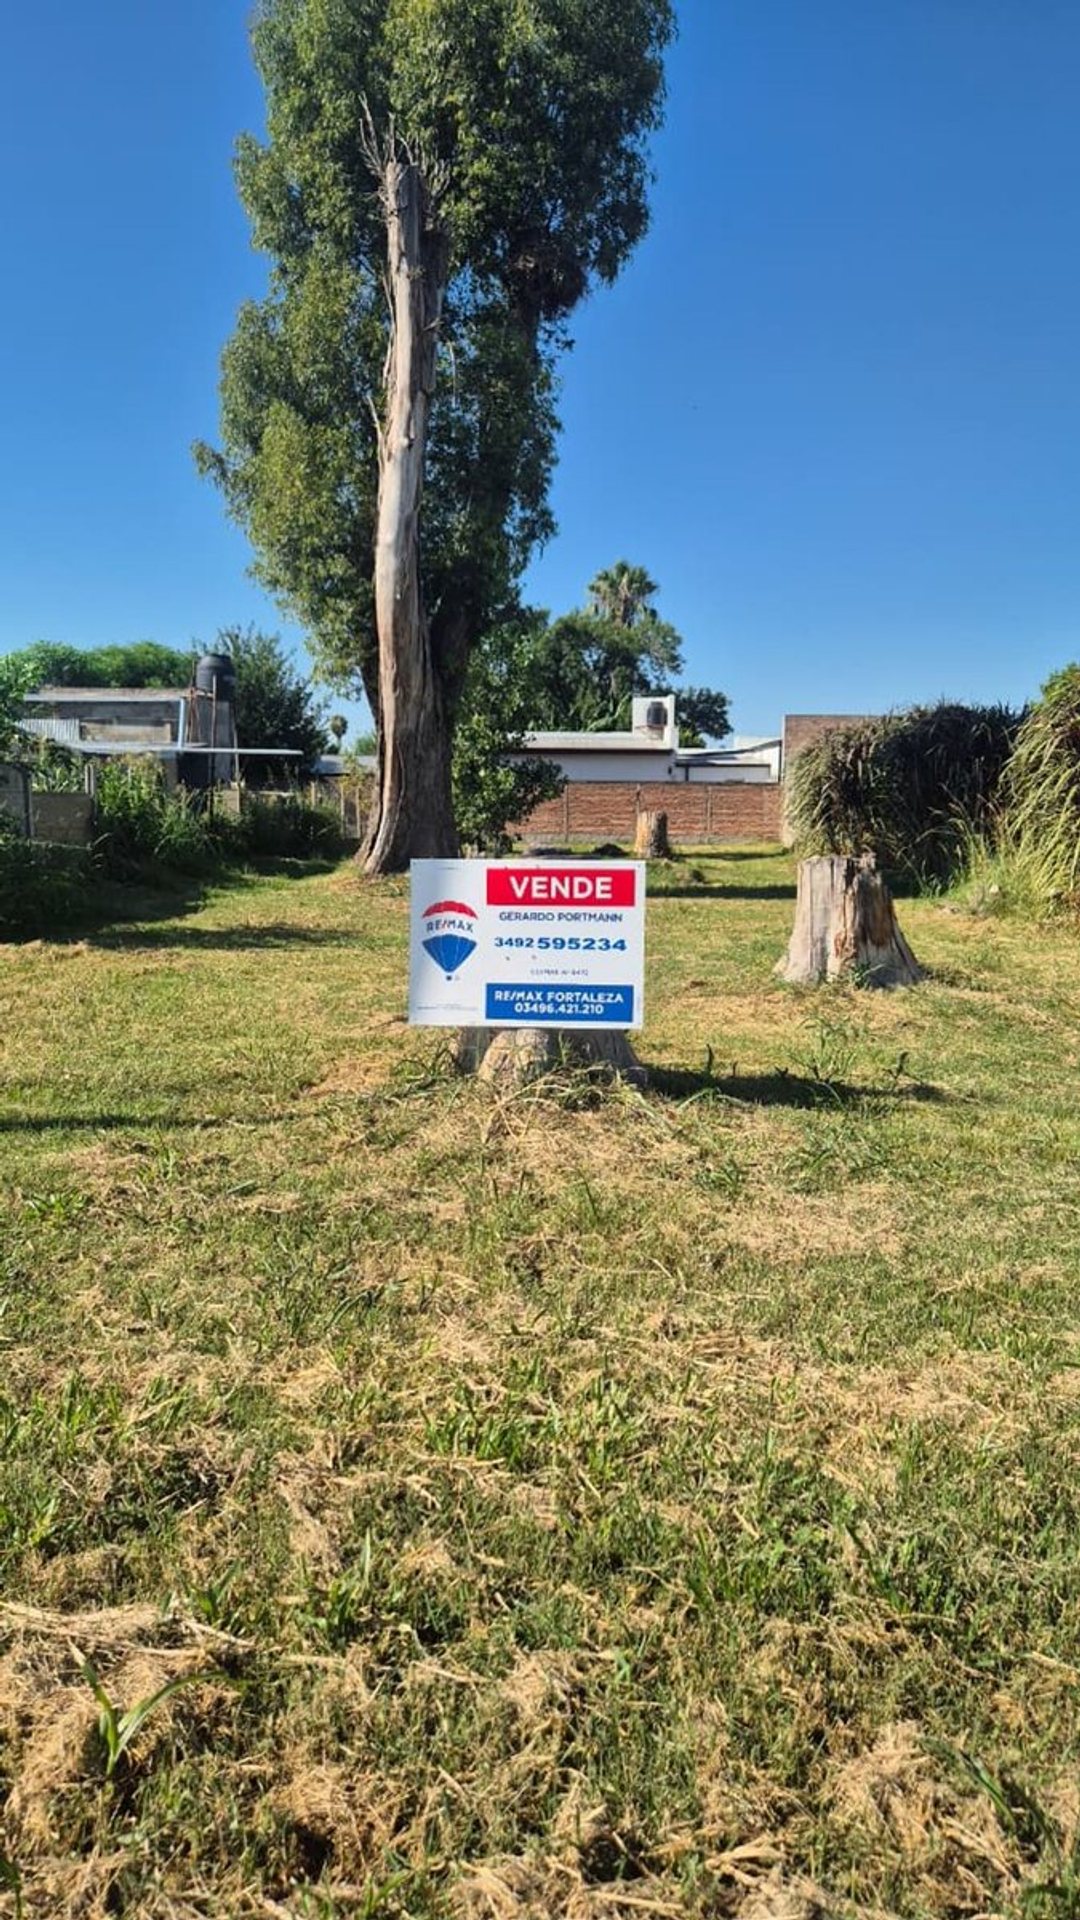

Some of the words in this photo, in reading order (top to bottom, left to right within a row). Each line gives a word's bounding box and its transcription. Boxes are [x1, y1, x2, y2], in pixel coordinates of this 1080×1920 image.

[510, 876, 613, 899] VENDE
[499, 911, 555, 922] GERARDO
[557, 912, 623, 923] PORTMANN
[426, 919, 473, 933] RE/MAX
[537, 937, 627, 951] 595234
[494, 991, 543, 1002] RE/MAX
[547, 992, 623, 1003] FORTALEZA
